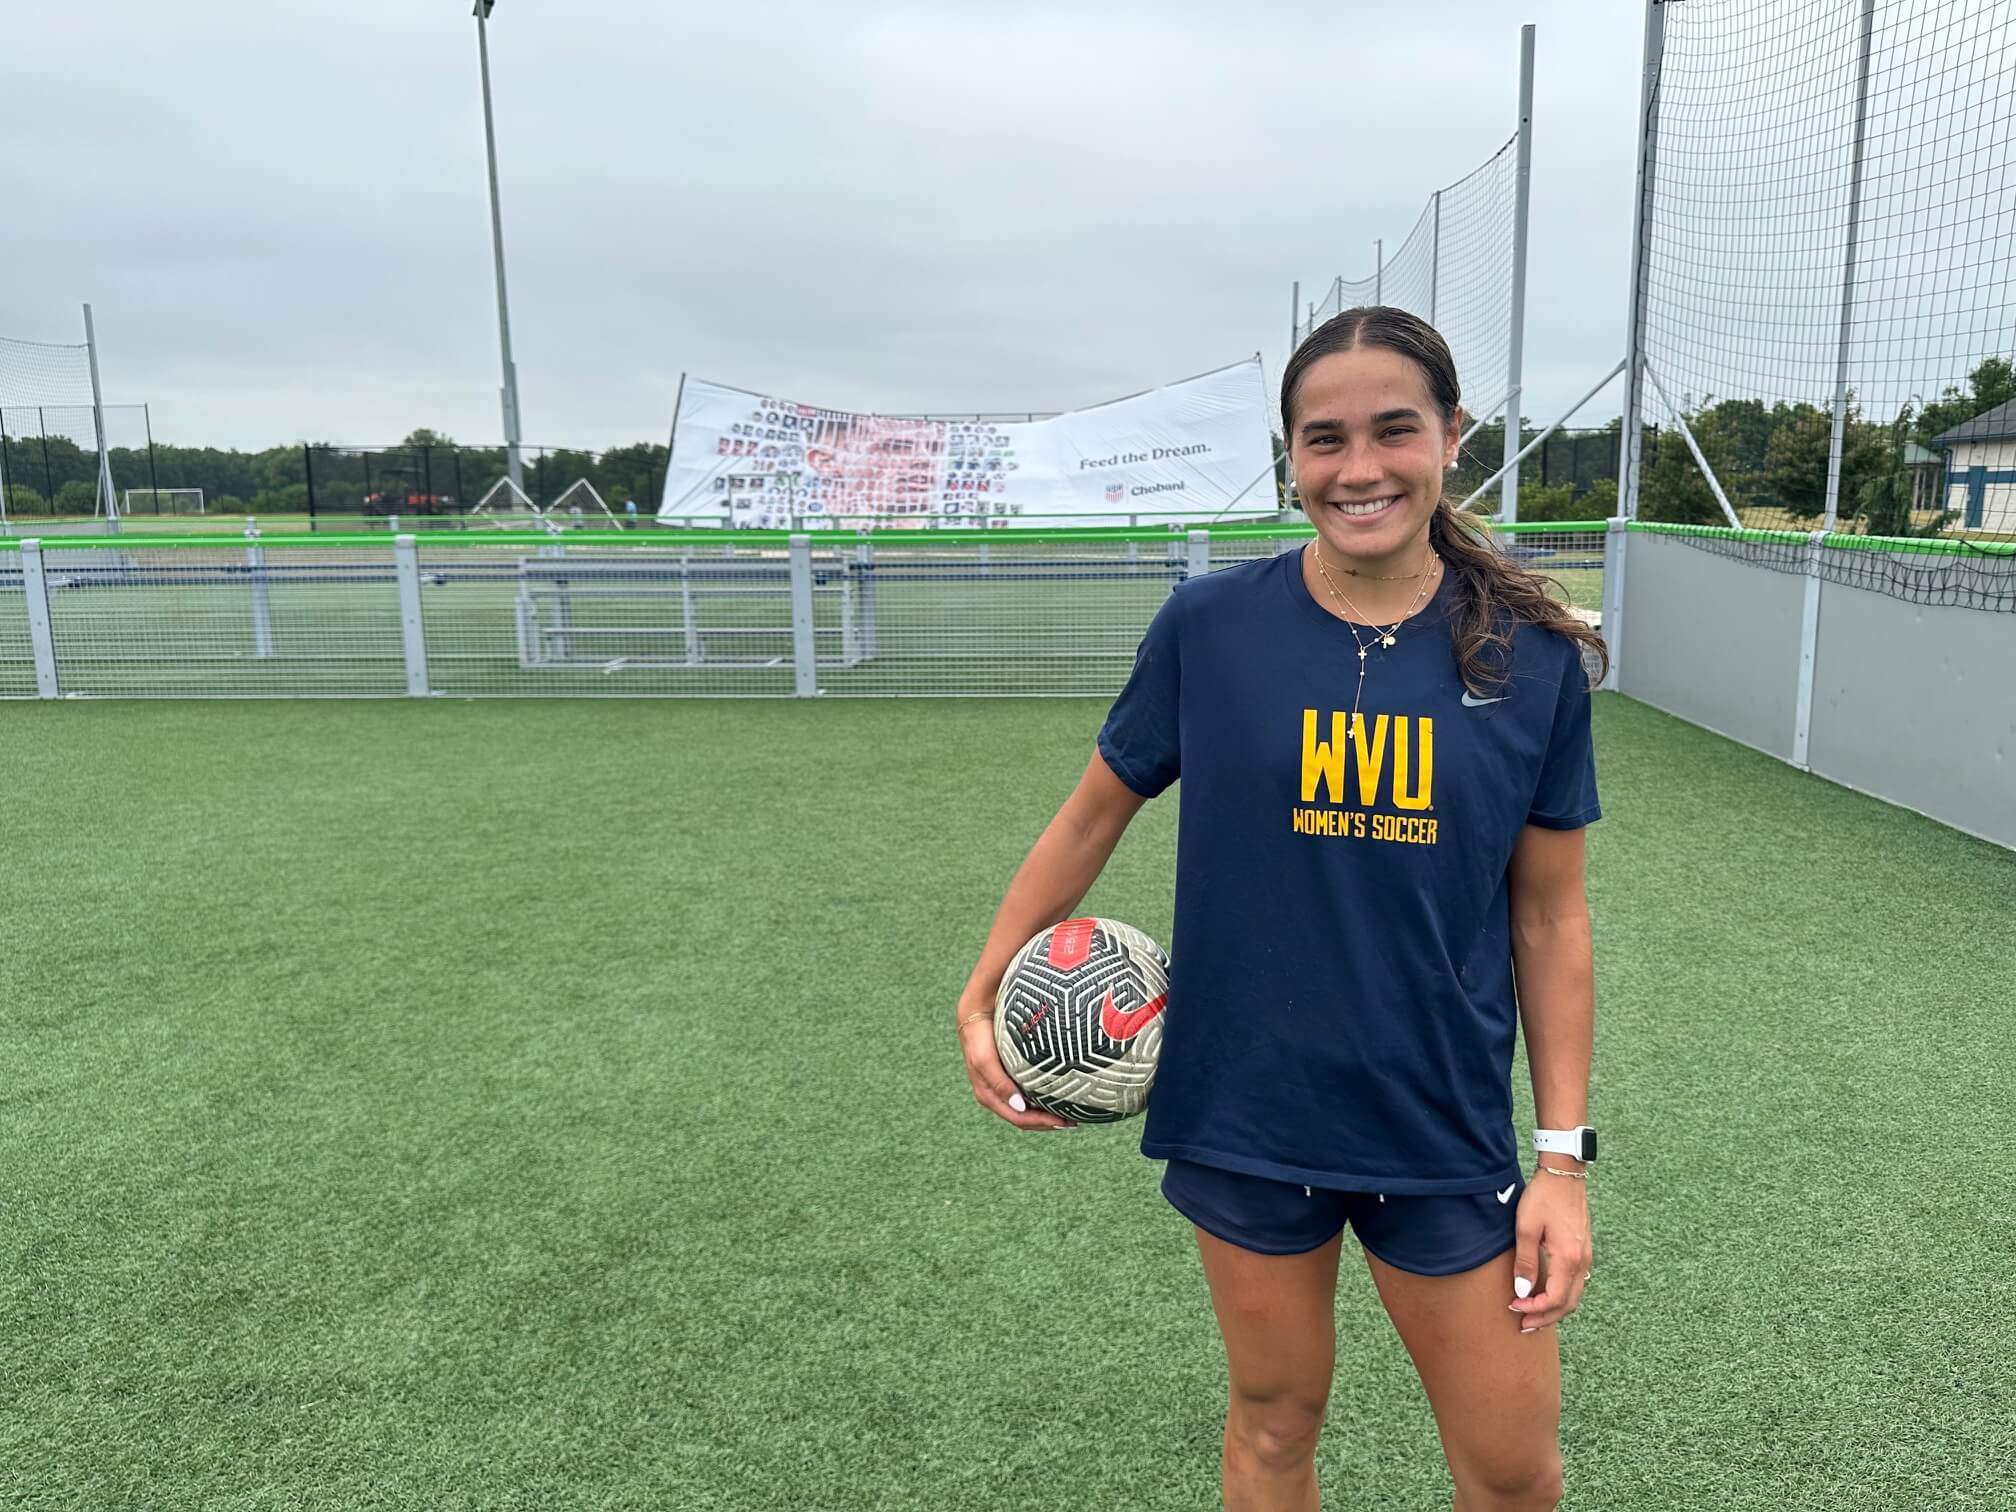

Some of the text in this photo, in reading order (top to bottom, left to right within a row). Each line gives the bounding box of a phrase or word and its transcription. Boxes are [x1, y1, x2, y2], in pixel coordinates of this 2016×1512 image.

[1080, 443, 1212, 470] Feed the Dream.
[1131, 480, 1185, 496] Chobani
[1301, 709, 1433, 811] WVU
[1293, 807, 1439, 845] WOMEN'S SOCCER
